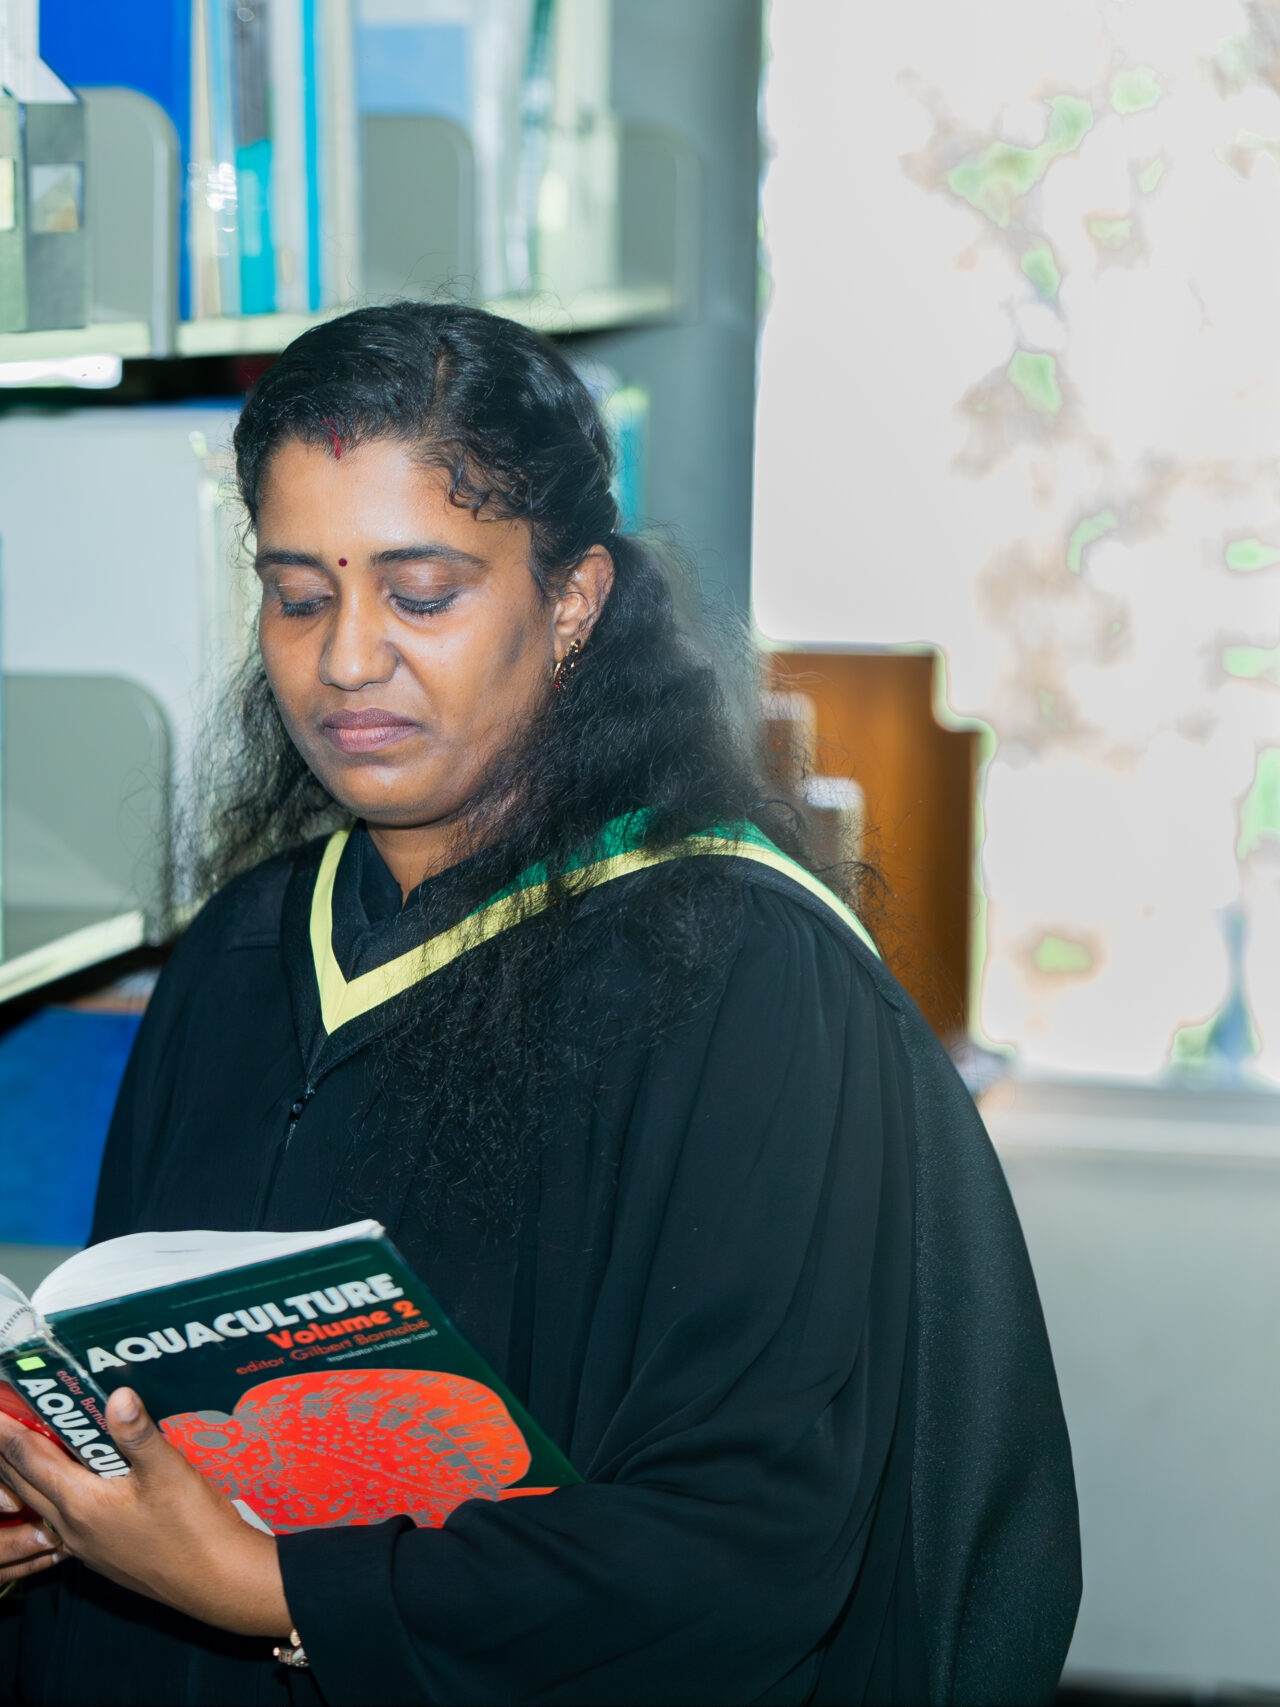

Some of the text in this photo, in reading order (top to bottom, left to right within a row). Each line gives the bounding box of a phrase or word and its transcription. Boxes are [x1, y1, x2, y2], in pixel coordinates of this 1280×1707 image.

[86, 1272, 405, 1374] AQUACULTURE
[266, 1300, 421, 1350] Volume 2
[235, 1356, 285, 1375] editor
[289, 1338, 353, 1361] Gilbert
[56, 1369, 86, 1396] editor
